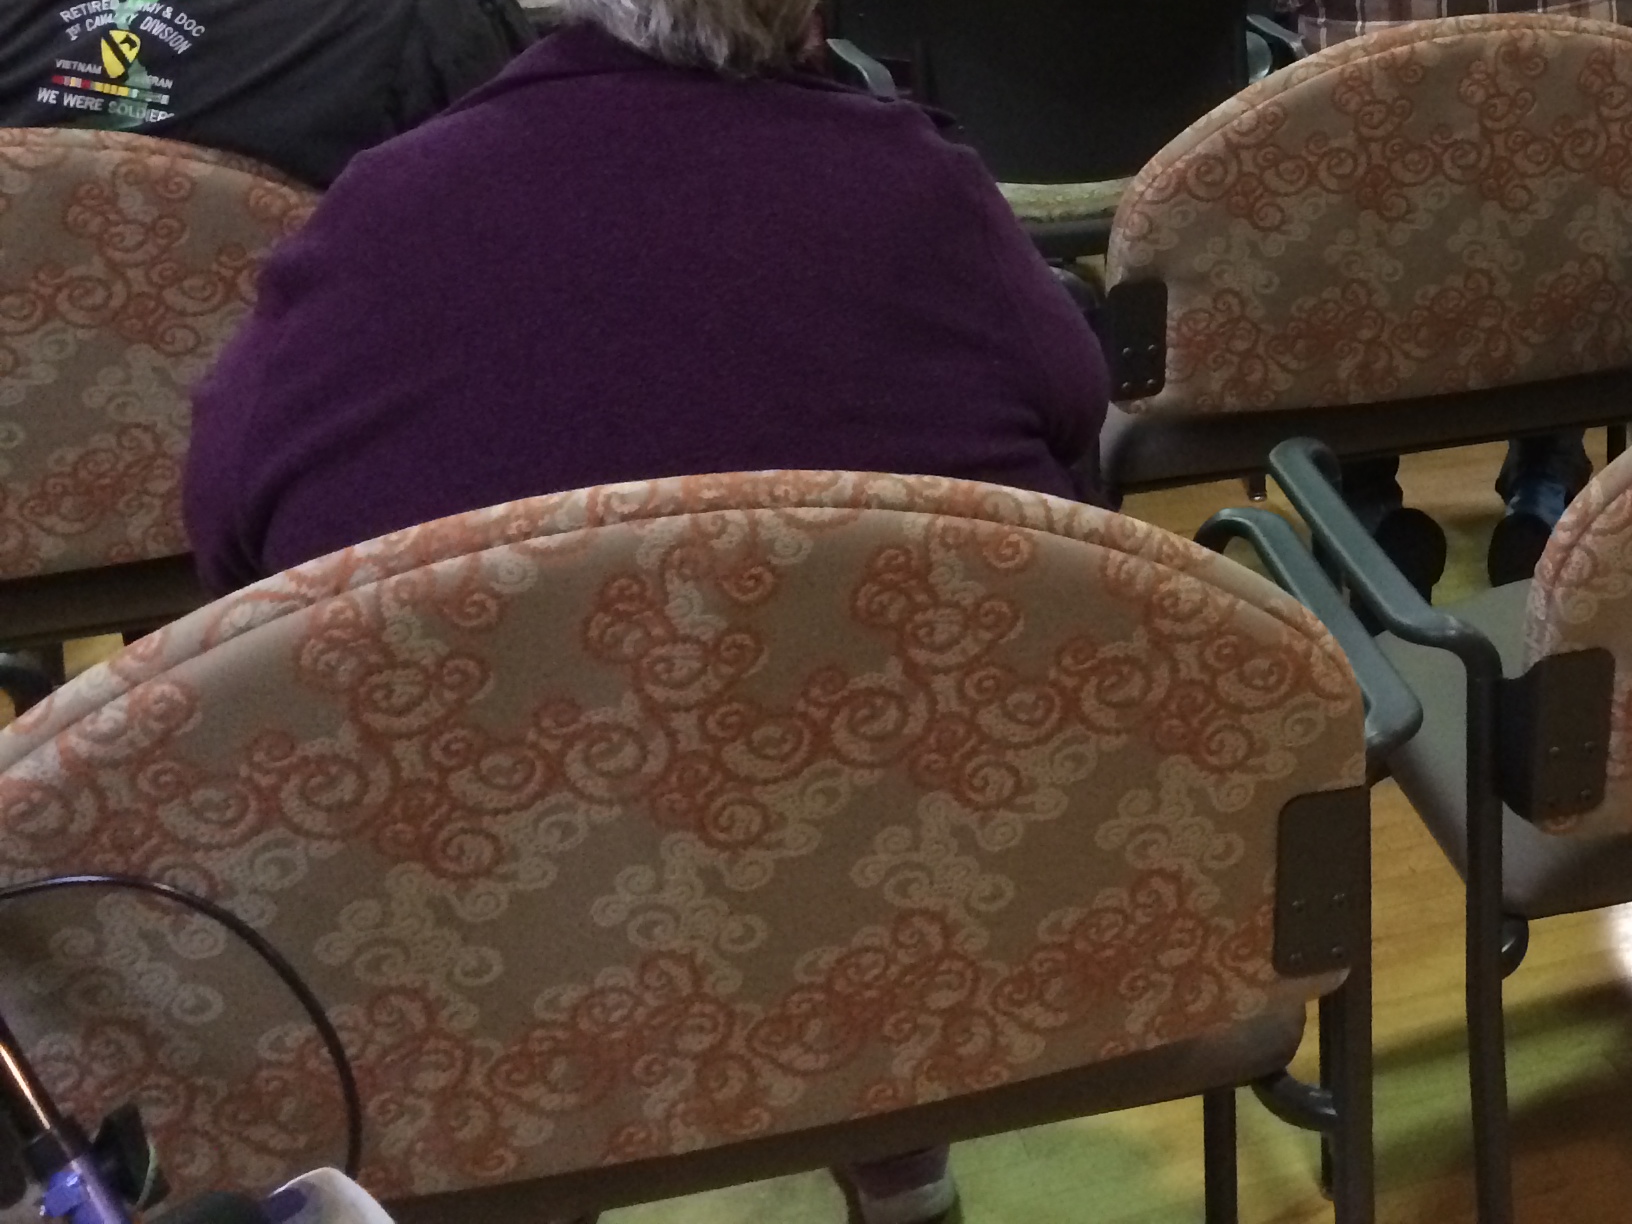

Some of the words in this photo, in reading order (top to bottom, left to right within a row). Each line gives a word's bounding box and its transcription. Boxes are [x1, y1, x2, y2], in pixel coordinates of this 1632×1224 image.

[140, 16, 193, 55] DIVISION
[162, 7, 174, 20] &
[174, 12, 206, 37] DOC
[55, 58, 102, 75] VIETNAM
[37, 87, 59, 104] WE
[63, 92, 104, 111] WERE
